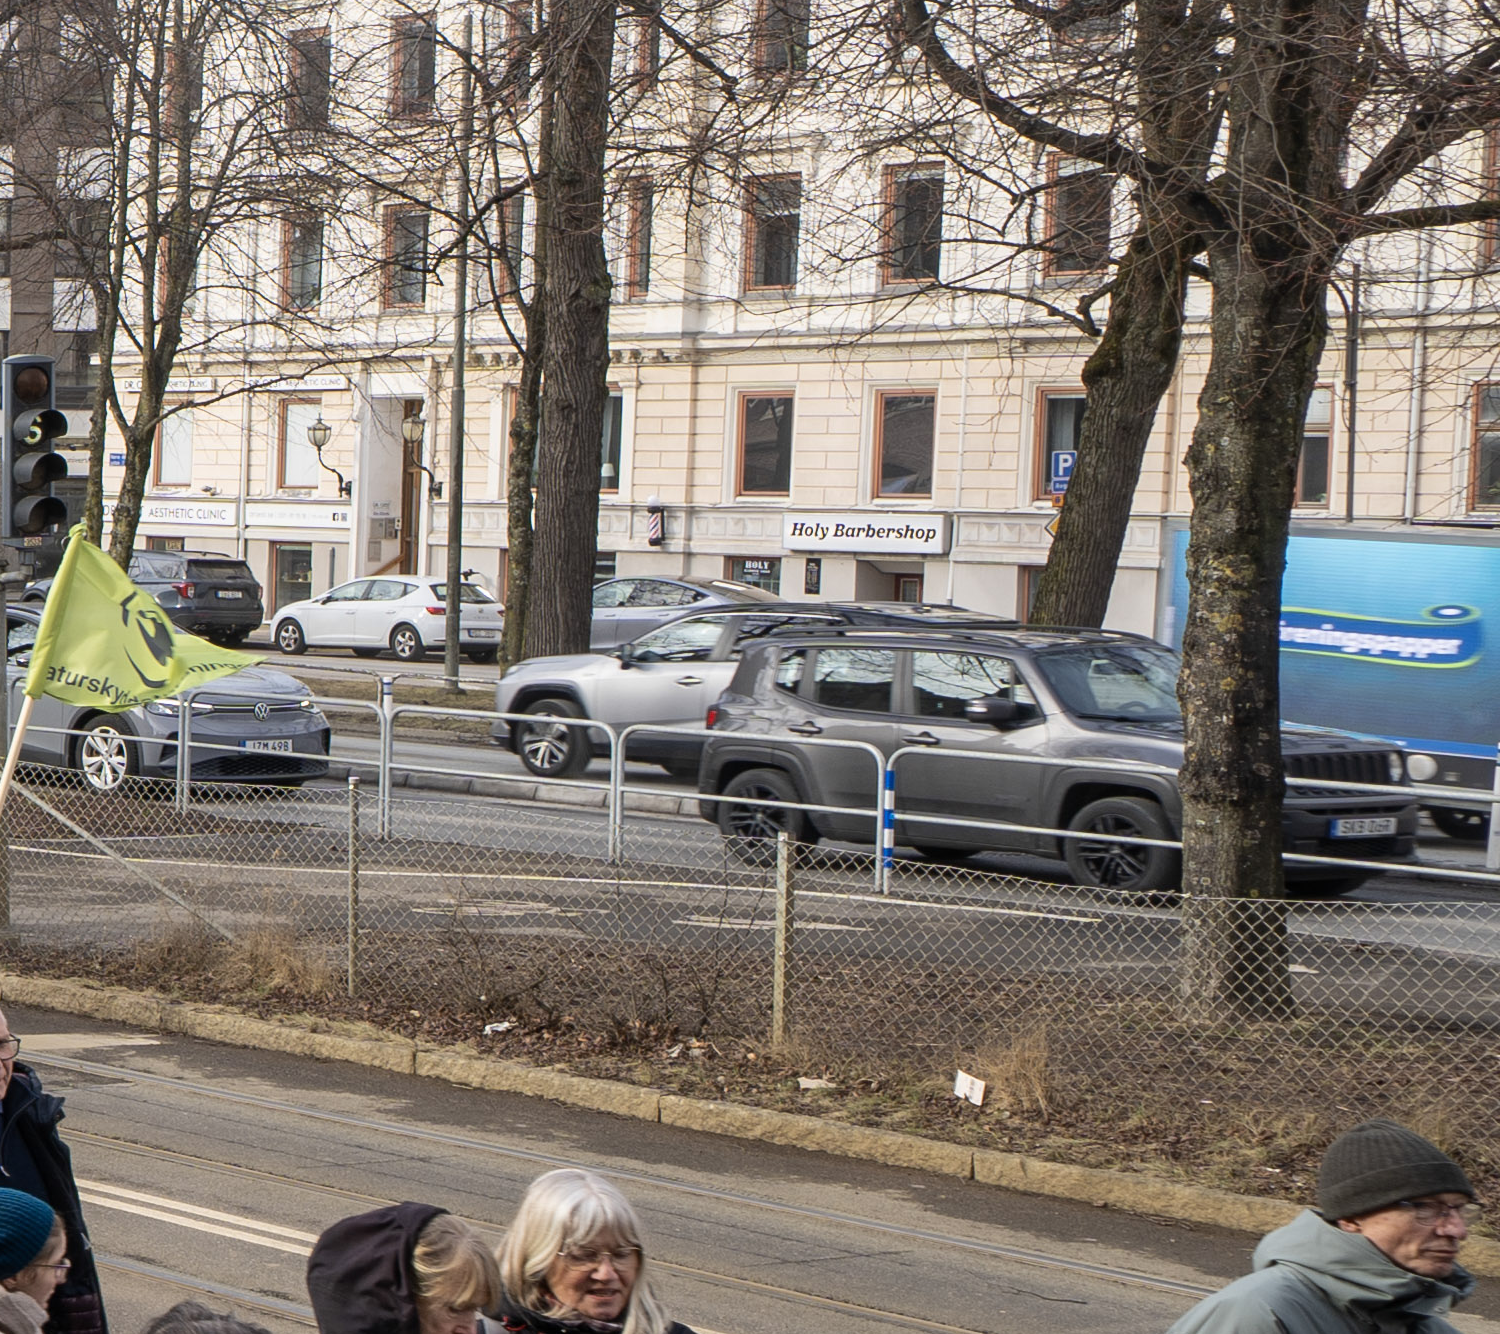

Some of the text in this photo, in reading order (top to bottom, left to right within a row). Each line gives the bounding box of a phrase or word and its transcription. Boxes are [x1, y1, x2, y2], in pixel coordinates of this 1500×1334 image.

[1058, 454, 1073, 476] P
[148, 507, 194, 519] AESTHETIC
[196, 509, 227, 521] CLINIC
[791, 523, 937, 542] Holy Barbershop
[271, 741, 289, 752] 49B
